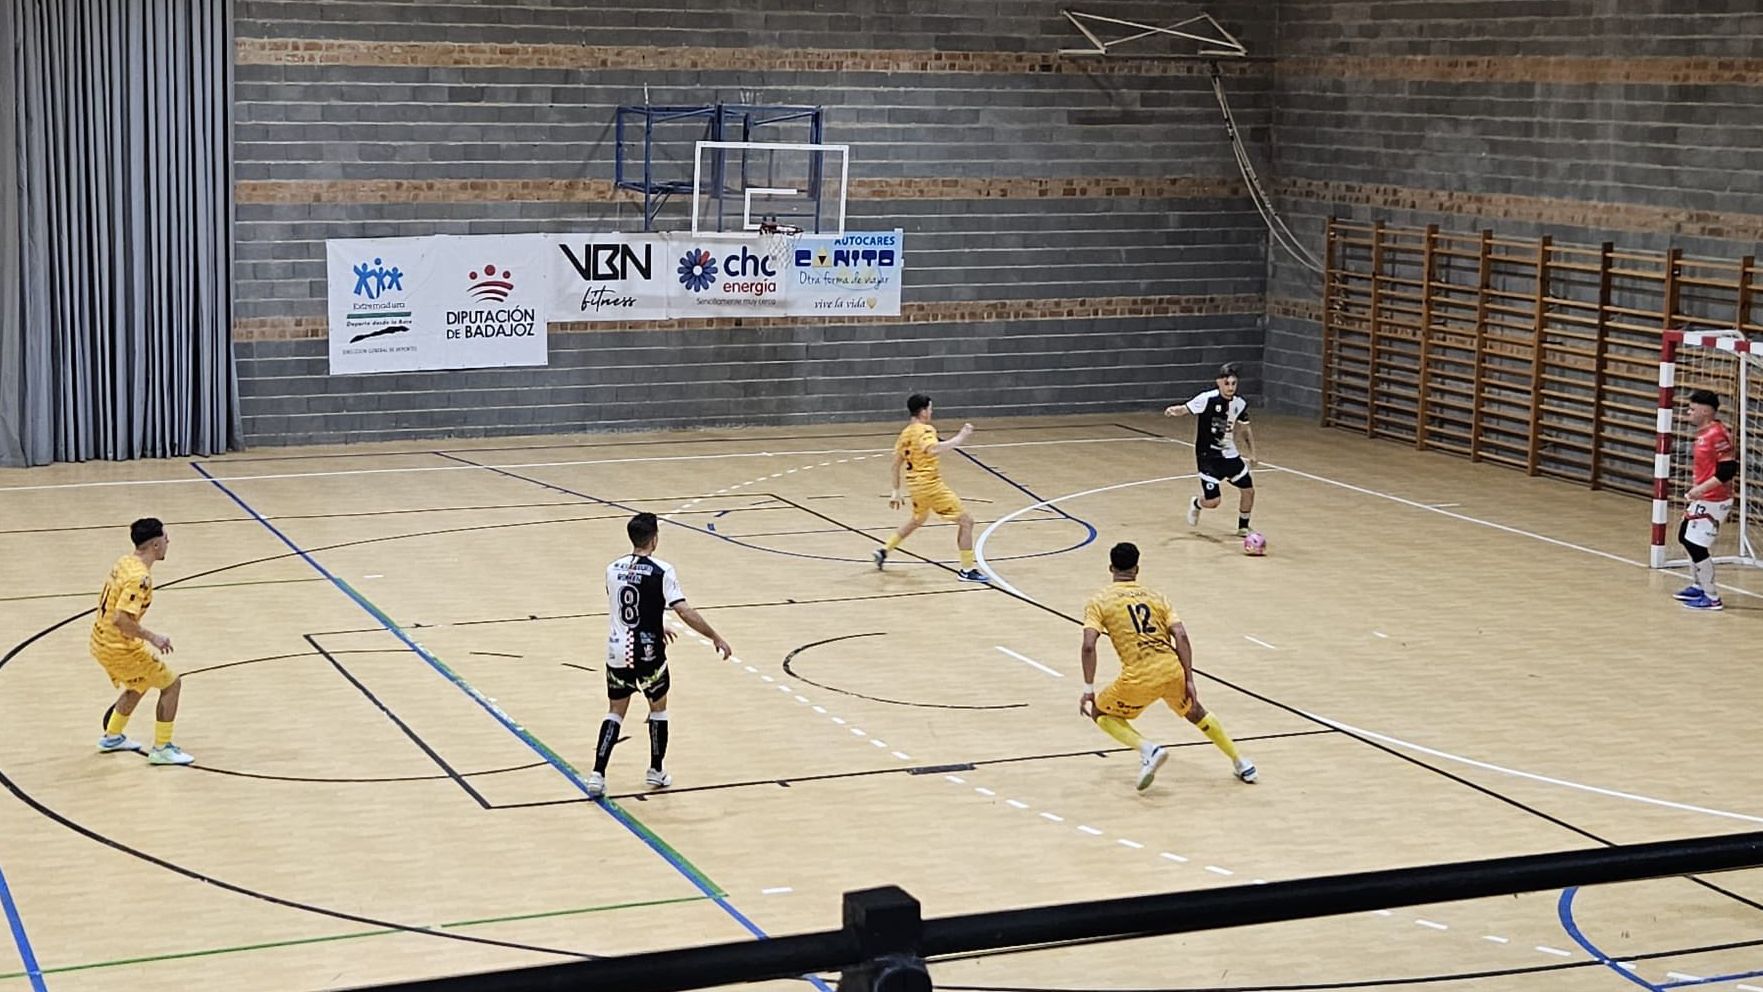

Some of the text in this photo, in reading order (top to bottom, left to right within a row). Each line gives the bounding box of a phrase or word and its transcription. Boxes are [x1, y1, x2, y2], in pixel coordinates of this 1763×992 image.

[558, 243, 652, 281] VBN
[723, 245, 776, 277] chc
[723, 278, 776, 296] energía
[823, 271, 848, 285] forma
[850, 271, 863, 285] de
[353, 301, 405, 310] Extremadura
[581, 285, 637, 312] fitness
[814, 297, 866, 309] vive la vida
[446, 305, 535, 325] DIPUTACIÓN
[446, 323, 535, 339] DE BADAJOZ
[618, 584, 640, 629] 8
[1126, 603, 1156, 634] 12
